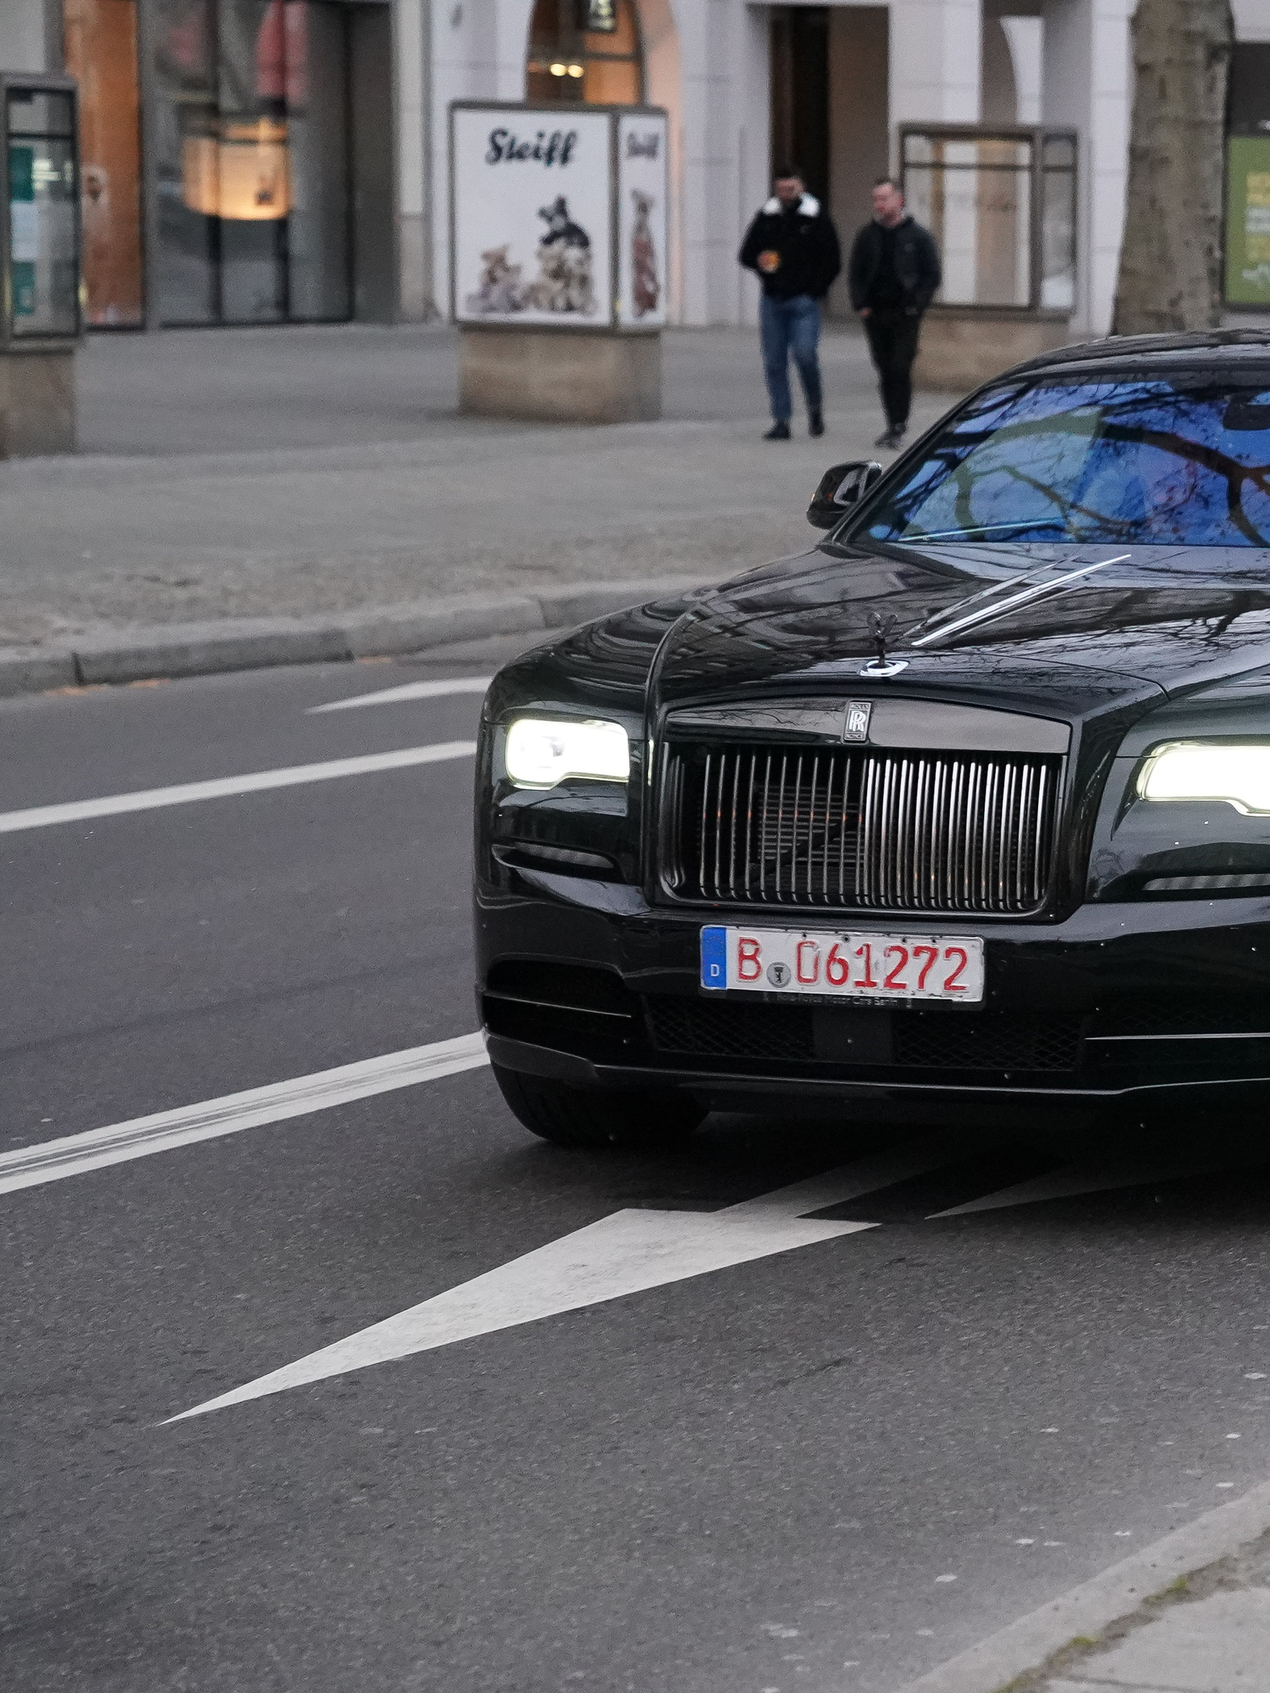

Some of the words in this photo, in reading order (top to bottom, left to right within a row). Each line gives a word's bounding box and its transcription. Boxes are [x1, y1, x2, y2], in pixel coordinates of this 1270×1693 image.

[486, 127, 577, 167] Steiff
[709, 963, 720, 977] D
[738, 938, 762, 980] B
[796, 941, 968, 991] 061272
